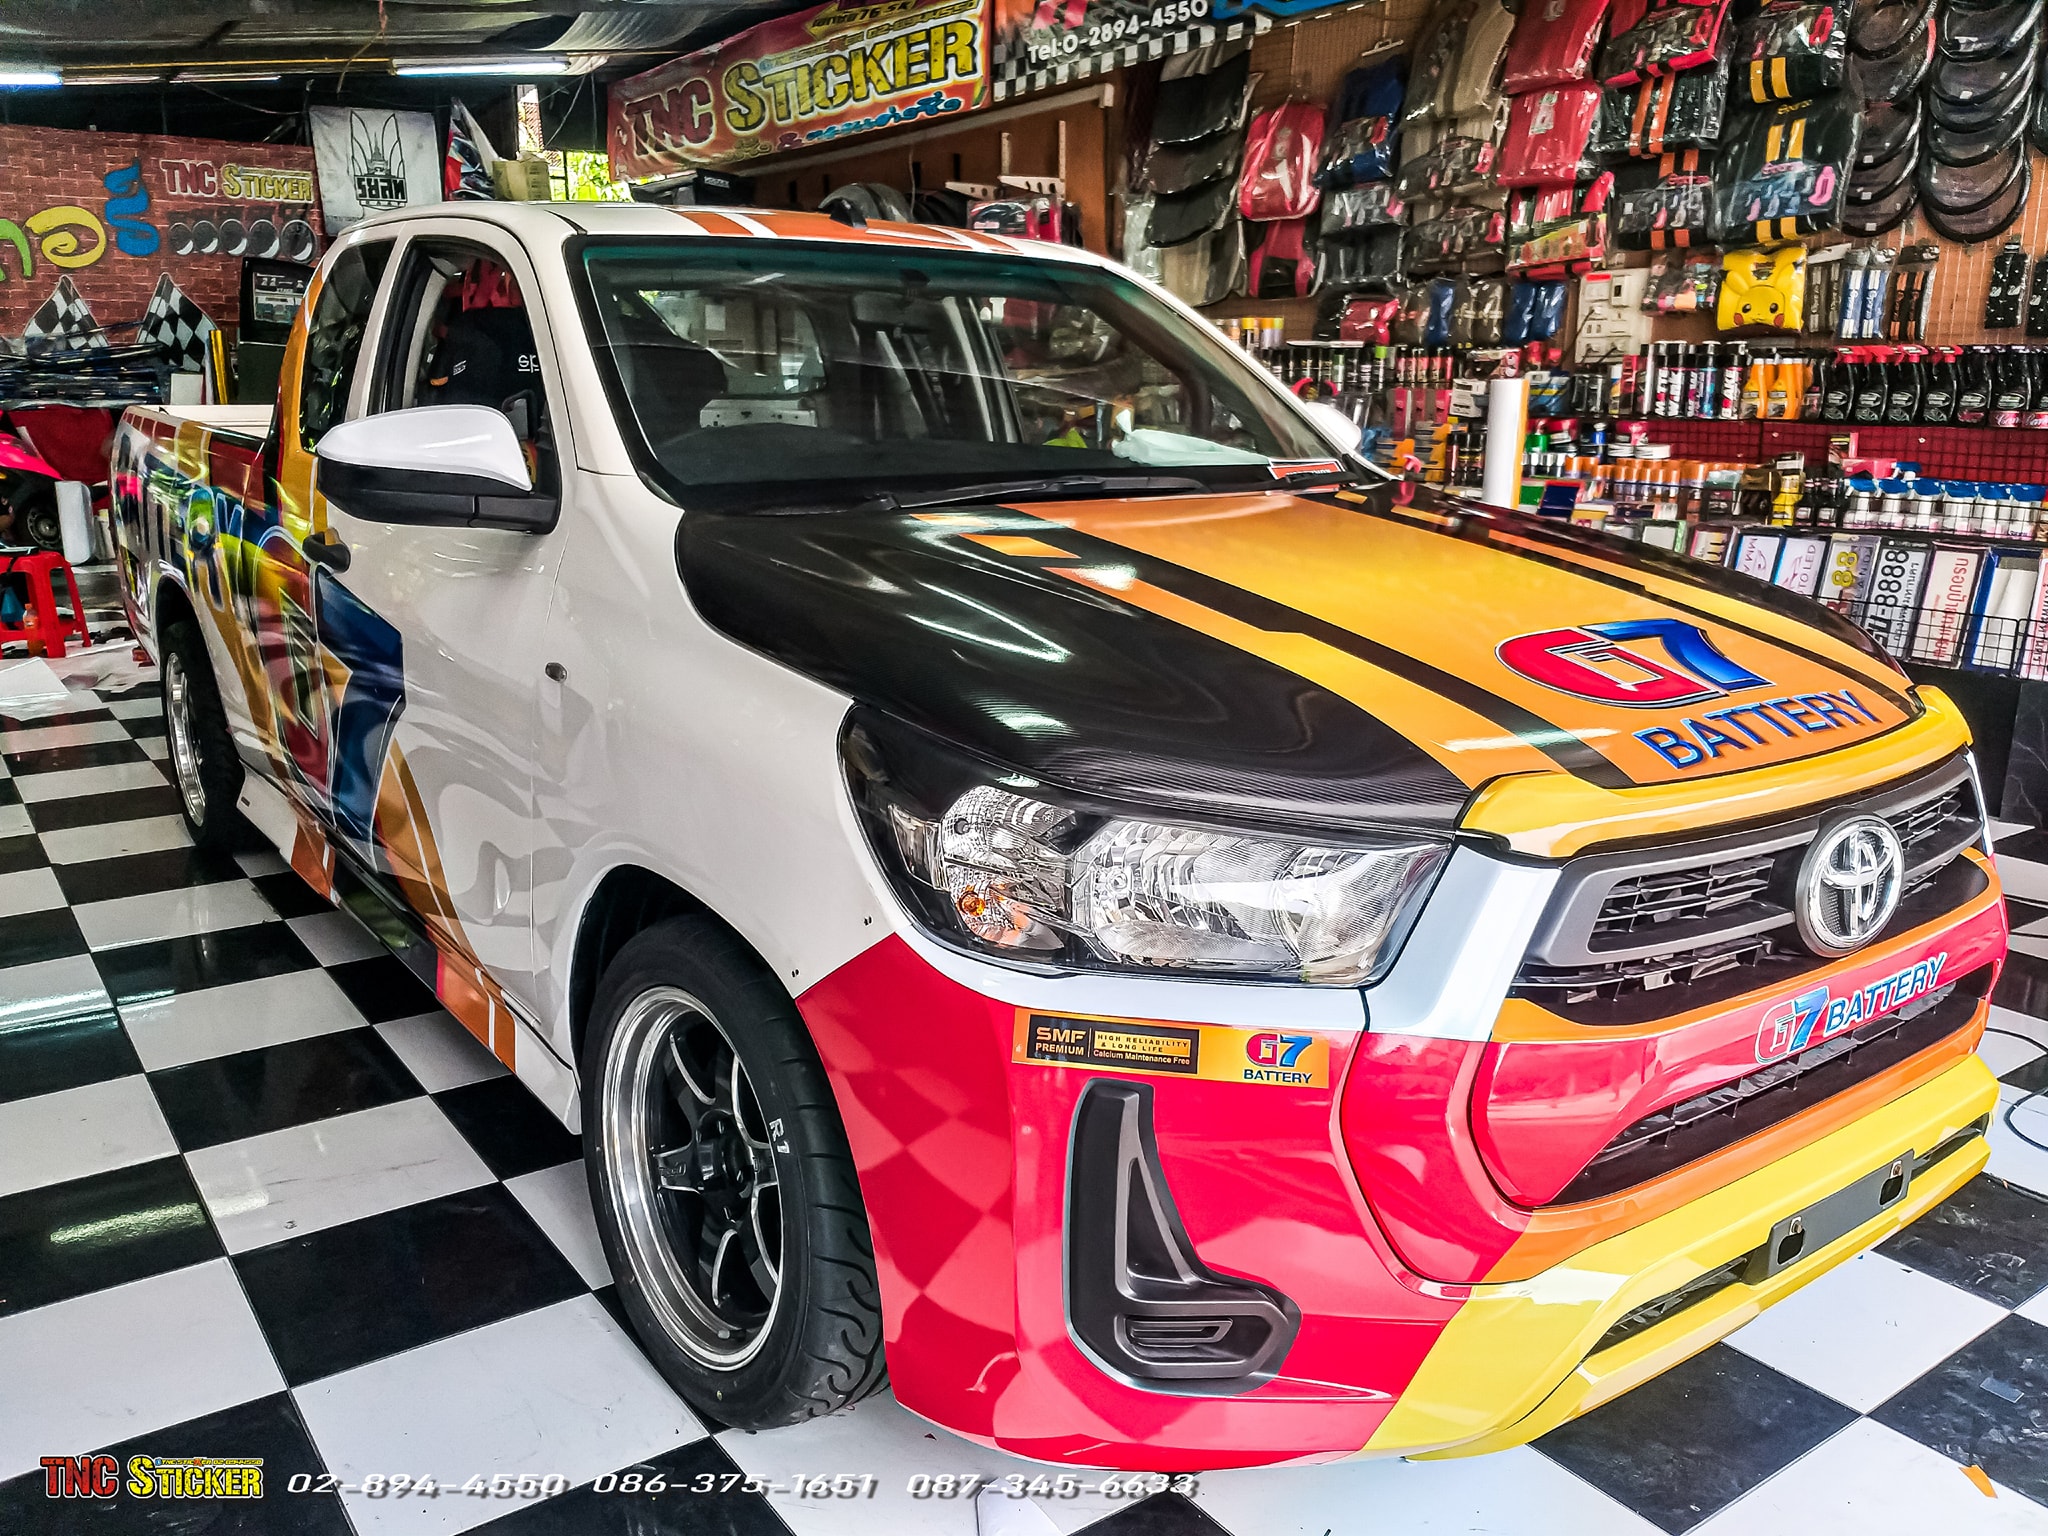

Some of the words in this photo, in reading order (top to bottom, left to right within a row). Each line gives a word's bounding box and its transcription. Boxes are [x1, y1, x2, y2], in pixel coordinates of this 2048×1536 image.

[624, 79, 714, 157] TNC
[725, 20, 978, 132] STICKER
[160, 159, 217, 196] TNC
[220, 163, 314, 203] STICKER
[1803, 544, 1816, 570] LED
[1494, 618, 1777, 709] G7
[1632, 689, 1882, 770] BATTERY
[1823, 952, 1948, 1037] BATTERY
[1036, 1026, 1087, 1044] SMF
[1097, 1034, 1121, 1042] HIGH
[1126, 1037, 1188, 1048] RELIABILITY
[1112, 1043, 1137, 1051] LONG
[1035, 1042, 1085, 1056] PREMIUM
[1093, 1050, 1124, 1060] Calcium
[1125, 1052, 1172, 1064] Maintenance
[1173, 1056, 1190, 1065] Free
[1246, 1032, 1313, 1069] G7
[1243, 1068, 1313, 1084] BATTERY
